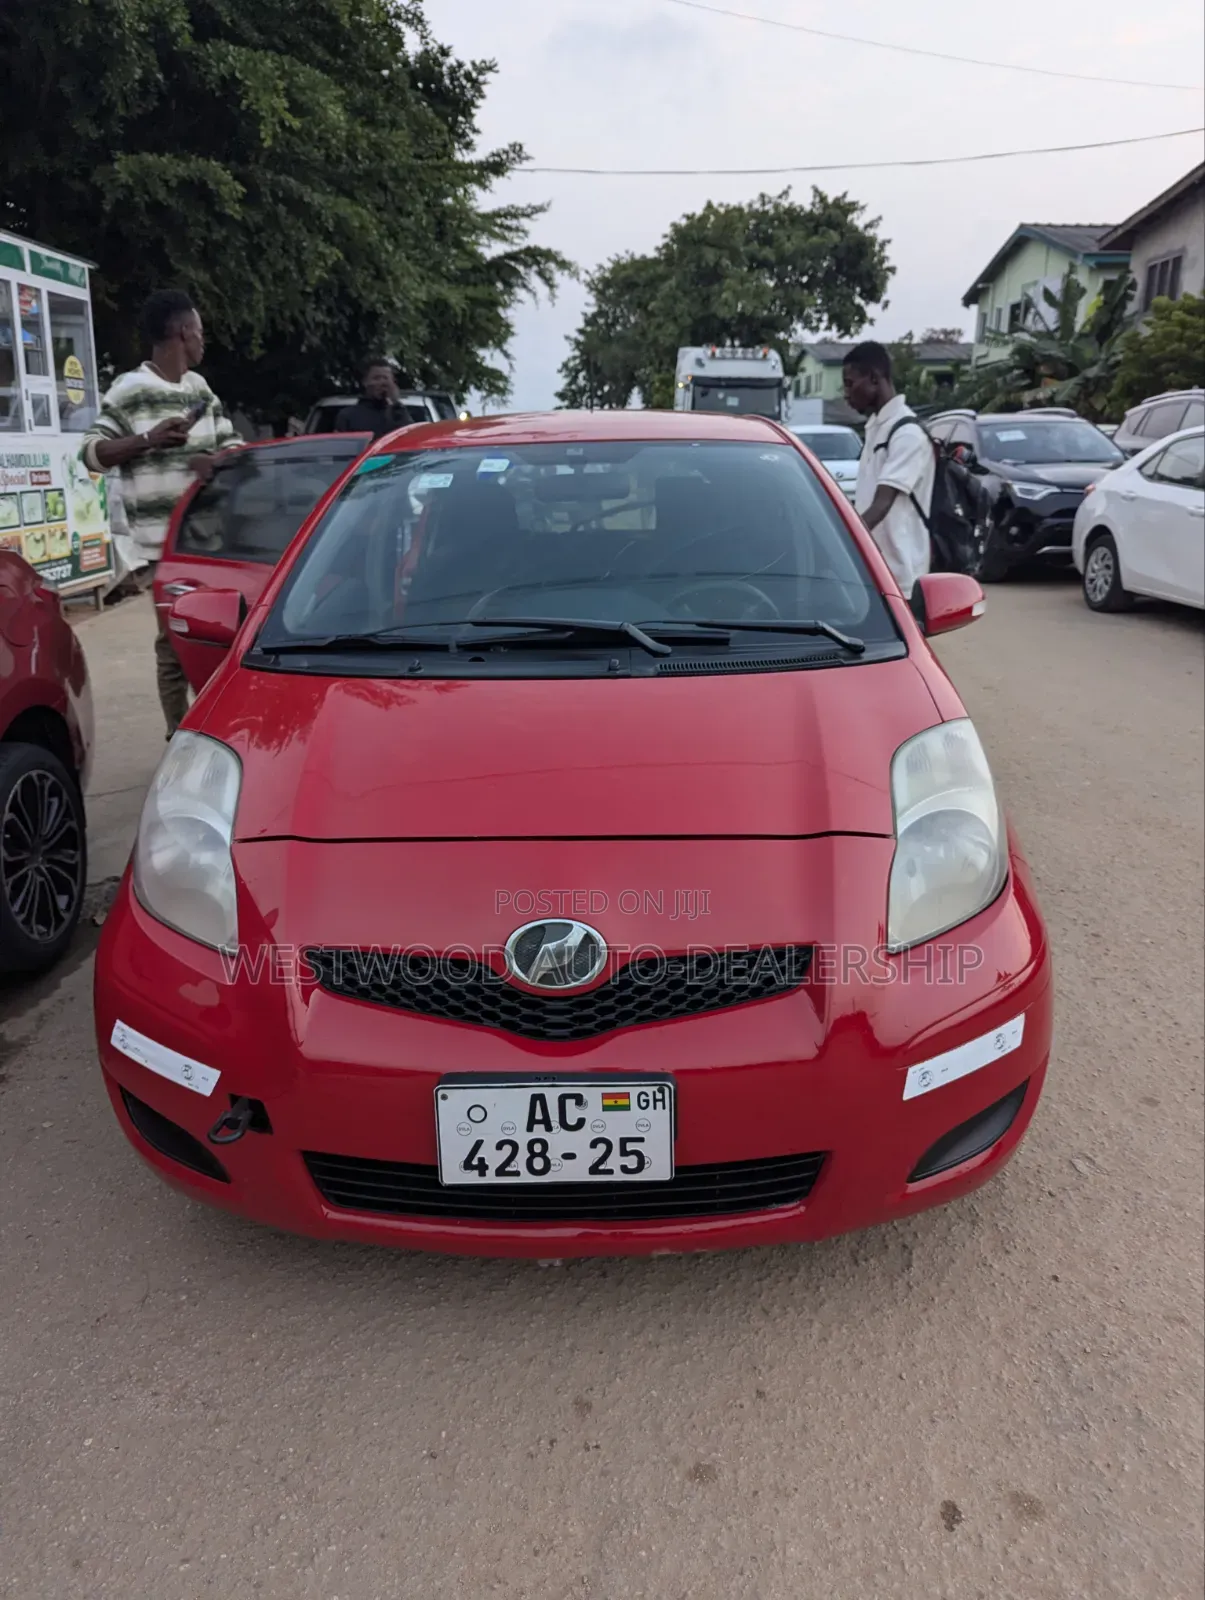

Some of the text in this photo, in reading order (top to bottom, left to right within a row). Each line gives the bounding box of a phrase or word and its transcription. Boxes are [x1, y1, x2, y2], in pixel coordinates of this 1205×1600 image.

[525, 1090, 666, 1133] AC GH
[463, 1136, 646, 1177] 428-25
